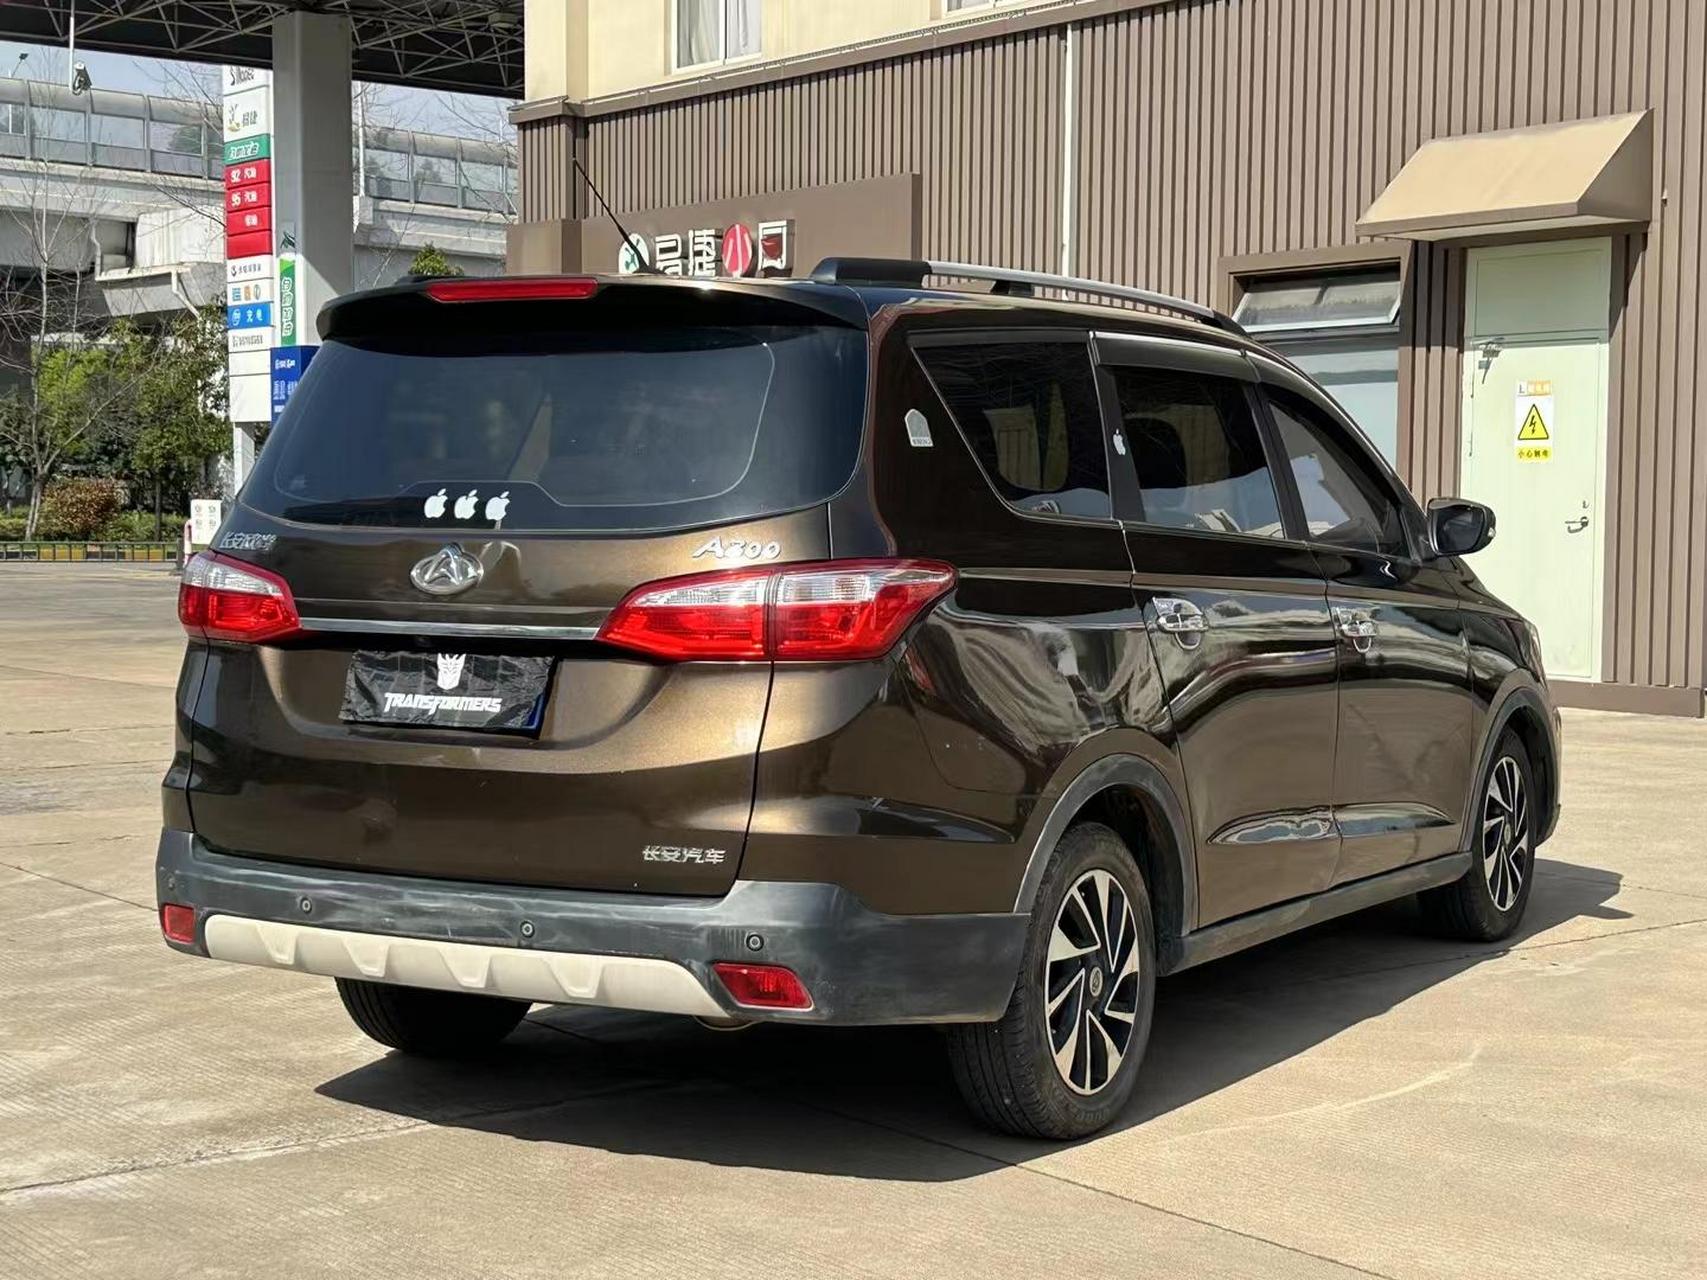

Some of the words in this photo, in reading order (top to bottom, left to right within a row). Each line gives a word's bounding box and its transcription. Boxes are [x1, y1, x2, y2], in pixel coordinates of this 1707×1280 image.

[383, 691, 503, 716] TRANSFORMERS
[641, 845, 727, 865] 长安汽车
